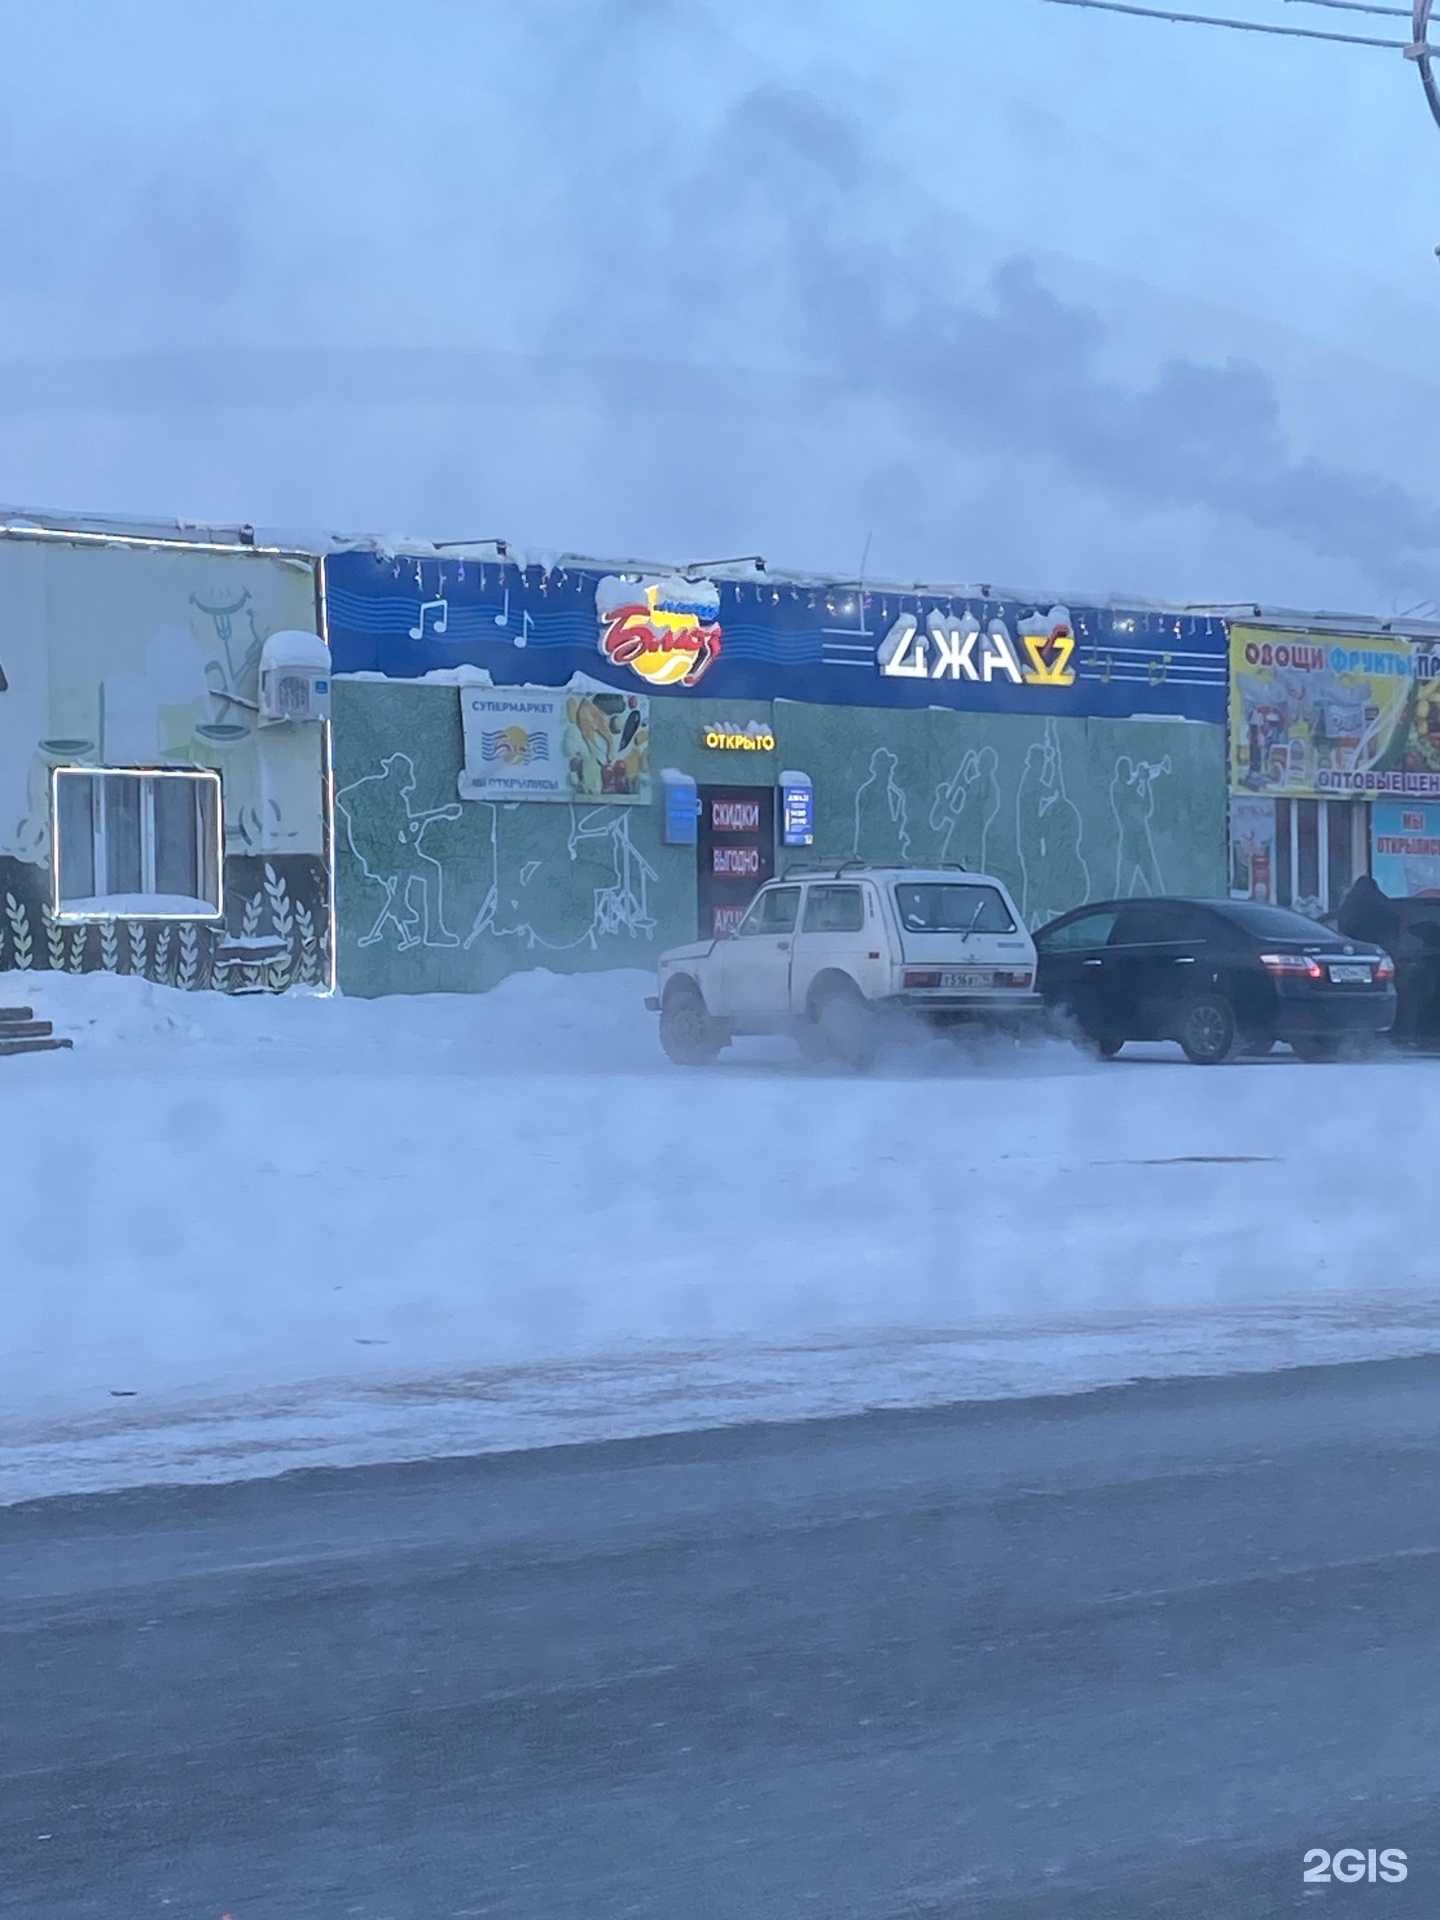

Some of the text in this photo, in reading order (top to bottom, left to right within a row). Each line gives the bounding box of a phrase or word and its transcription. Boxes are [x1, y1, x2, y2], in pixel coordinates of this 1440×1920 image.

[1245, 642, 1324, 672] ОВОЩИ
[1329, 646, 1415, 675] ФРУКТЫ
[472, 700, 554, 714] СУПЕРМАРКЕТ
[706, 732, 775, 751] ОТКРЫТО
[1318, 769, 1402, 791] ОПТОВЫЕ
[712, 803, 759, 831] СКИДКИ
[713, 850, 759, 876] ВЫГОДНО
